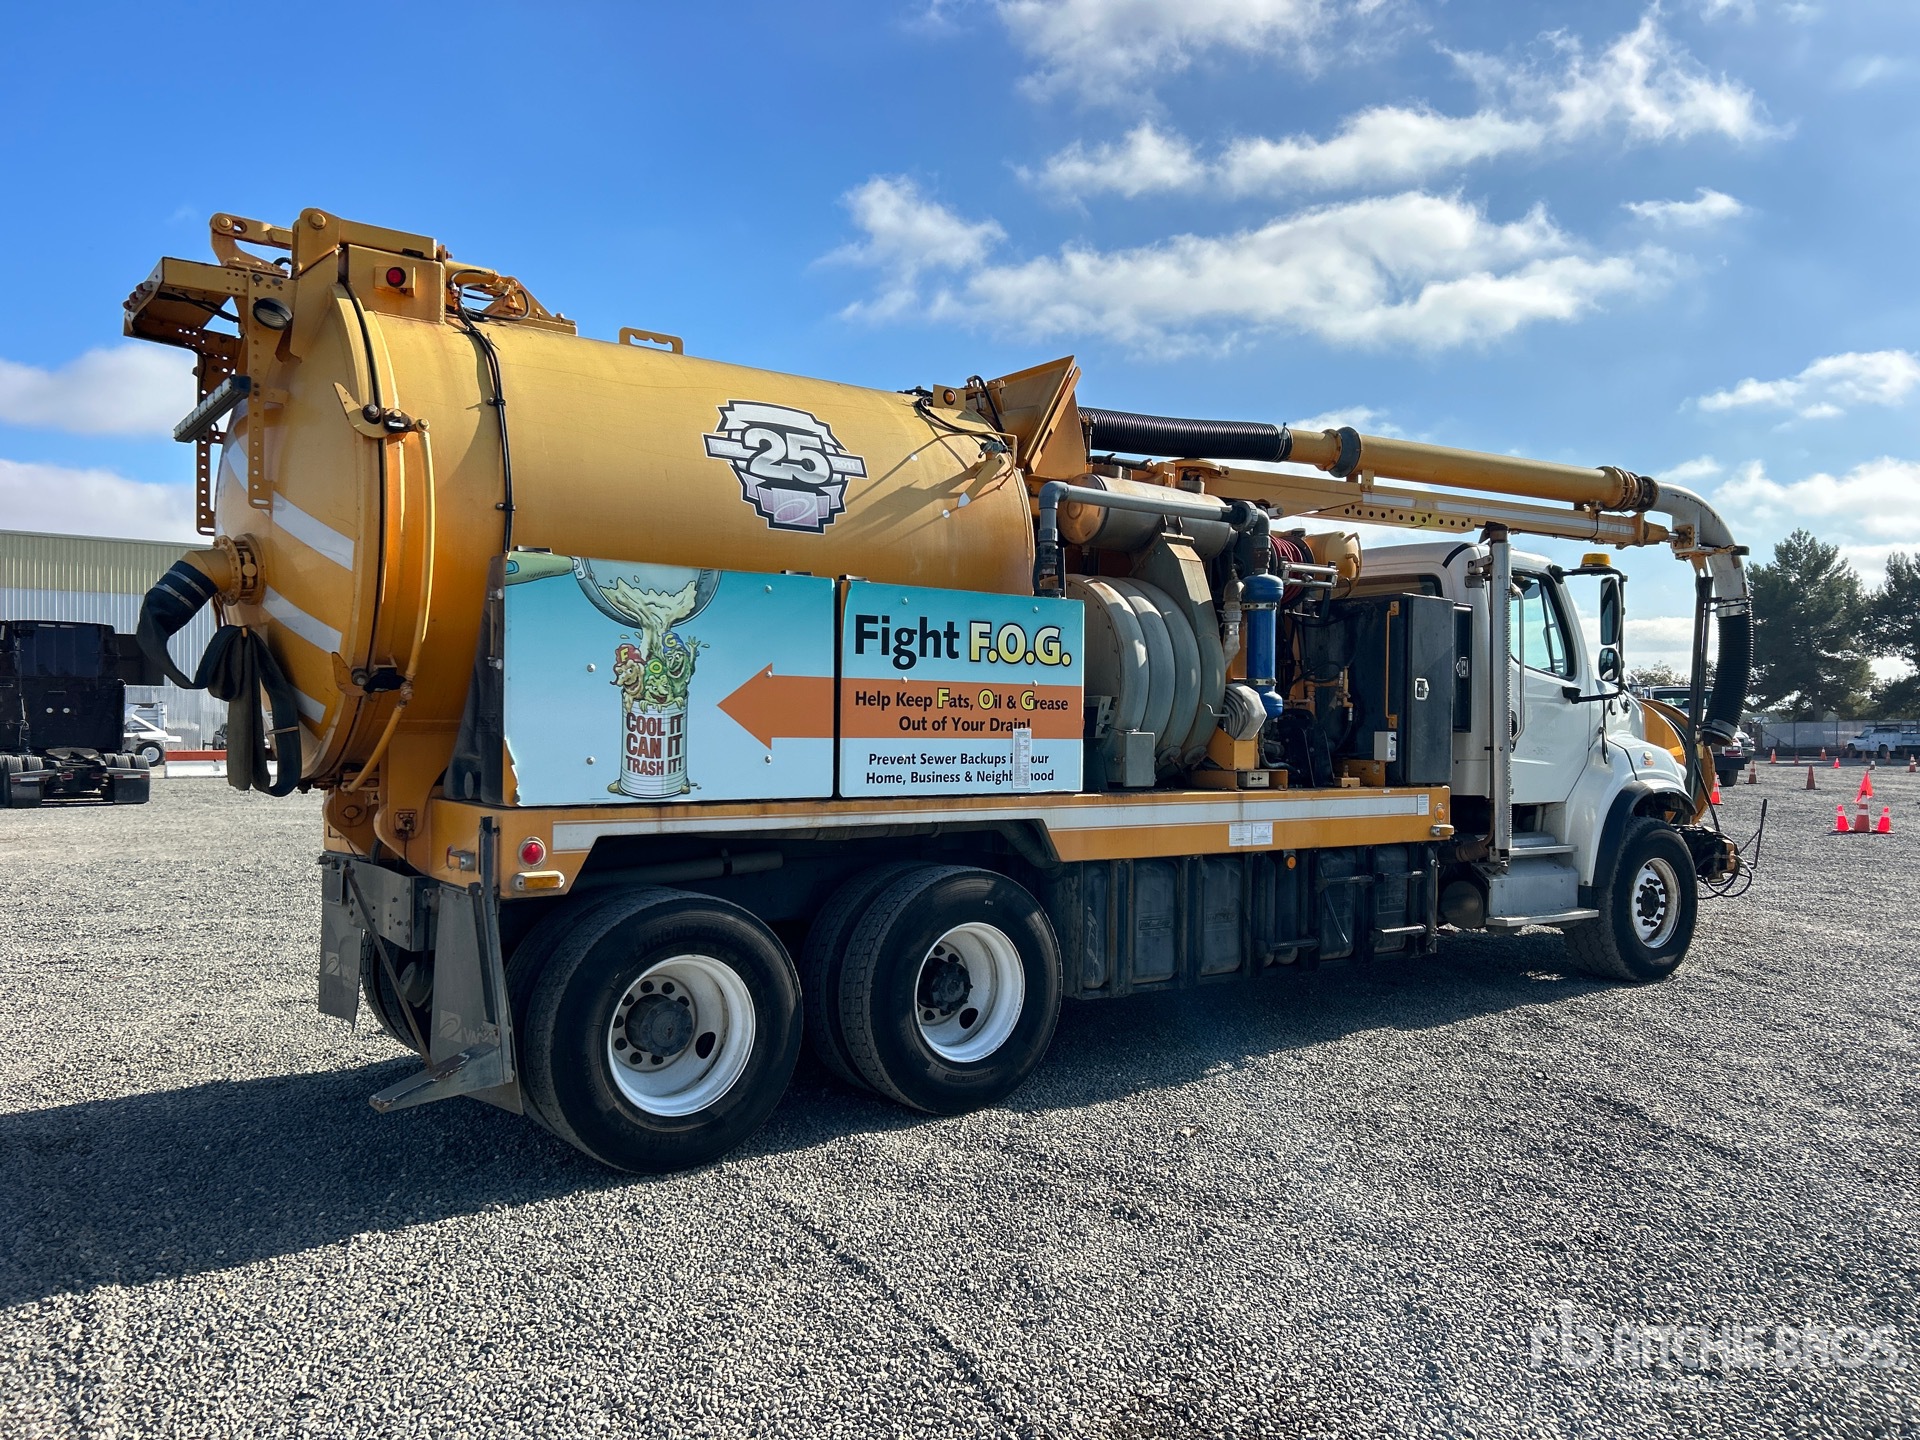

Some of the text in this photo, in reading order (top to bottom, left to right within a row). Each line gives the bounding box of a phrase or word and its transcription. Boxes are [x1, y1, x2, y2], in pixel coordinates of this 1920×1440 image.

[744, 427, 831, 484] 25
[664, 634, 677, 647] G
[854, 614, 1072, 670] Fight F.O.G.
[620, 647, 629, 662] F
[855, 687, 1069, 712] Help Keep Fats, Oil & Grease
[626, 712, 684, 736] COOL IT
[899, 716, 1031, 732] Out of Your Drain!
[626, 733, 683, 759] CAN IT
[626, 755, 682, 776] TRASH IT!
[869, 753, 917, 765] Prevent
[920, 753, 957, 765] Sewer
[960, 752, 1007, 767] Backups
[866, 772, 906, 785] Home,
[910, 771, 960, 783] Business
[964, 771, 973, 783] &
